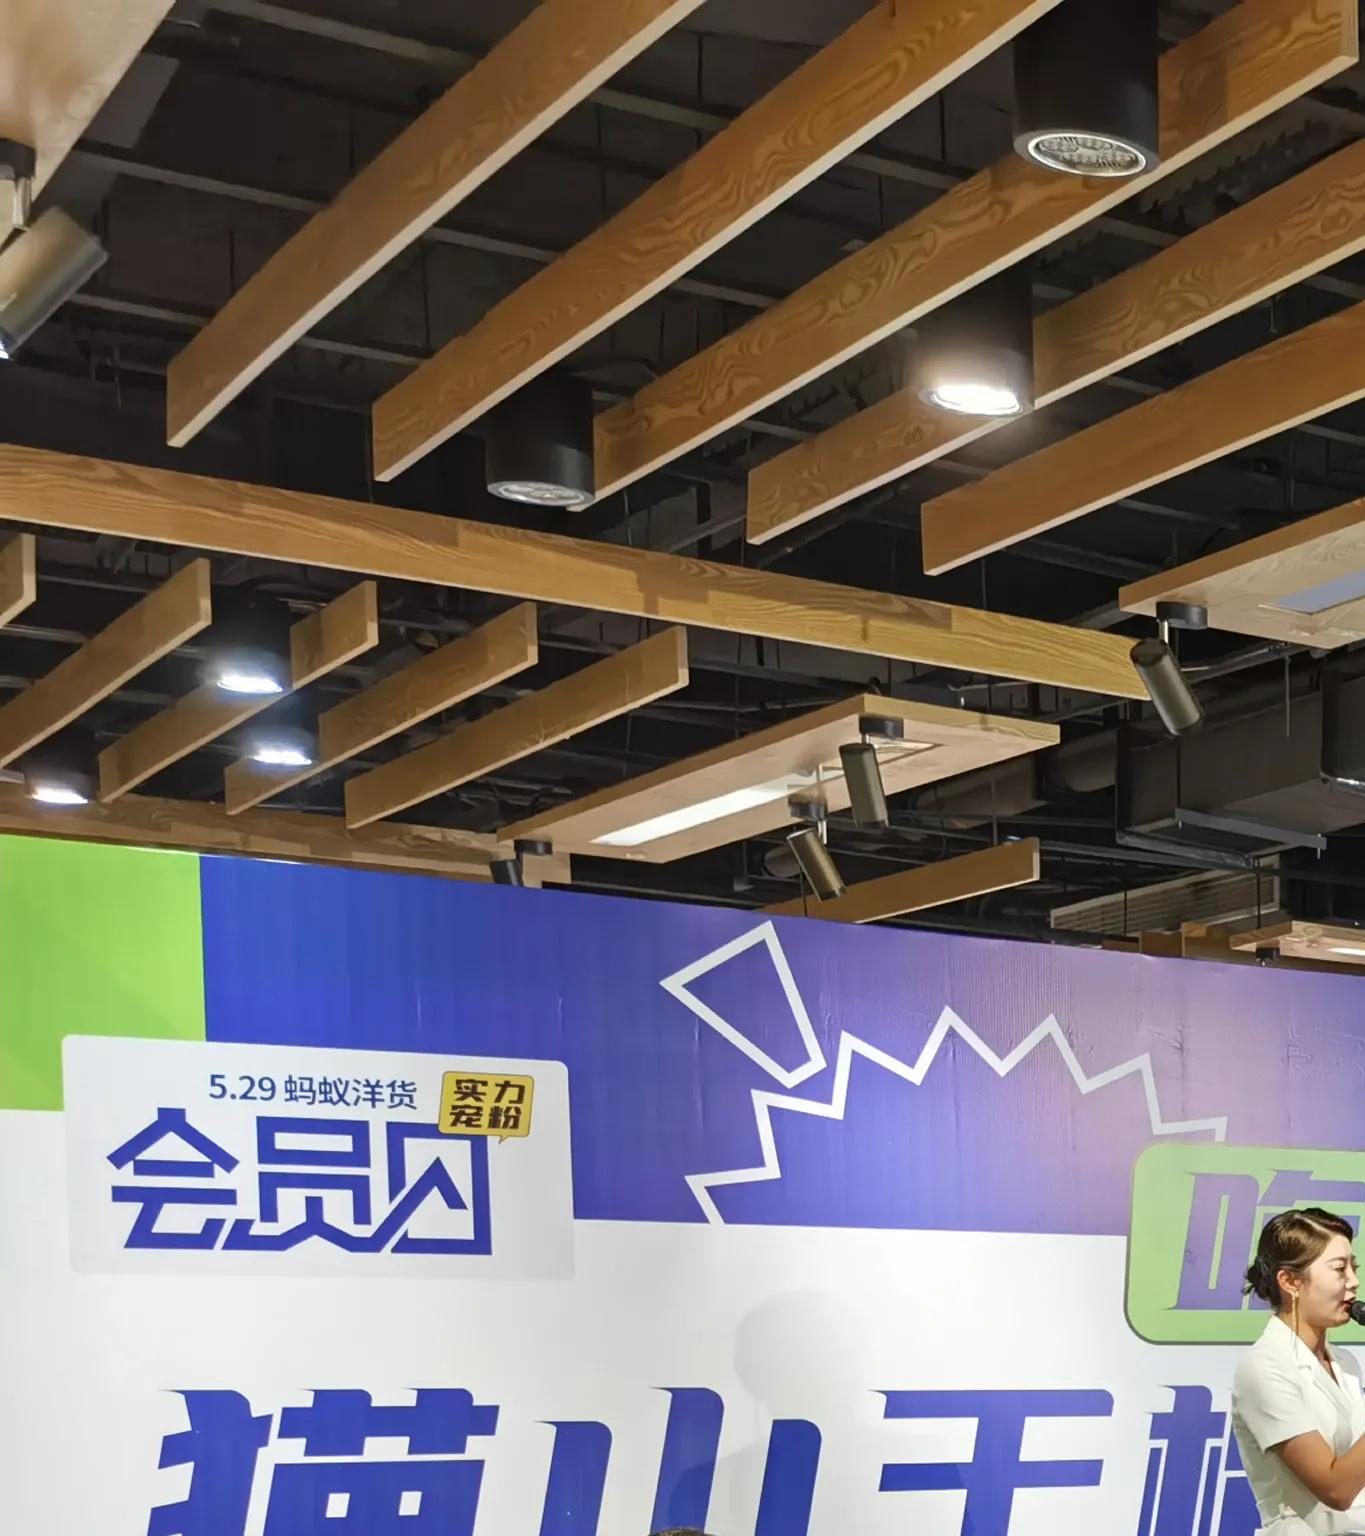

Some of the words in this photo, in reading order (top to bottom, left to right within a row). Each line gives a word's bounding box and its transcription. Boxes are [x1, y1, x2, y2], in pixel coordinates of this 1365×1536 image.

[209, 1074, 277, 1101] 5.29
[284, 1075, 418, 1110] 蚂蚁洋货
[453, 1079, 527, 1104] 实力
[449, 1104, 523, 1130] 宠粉
